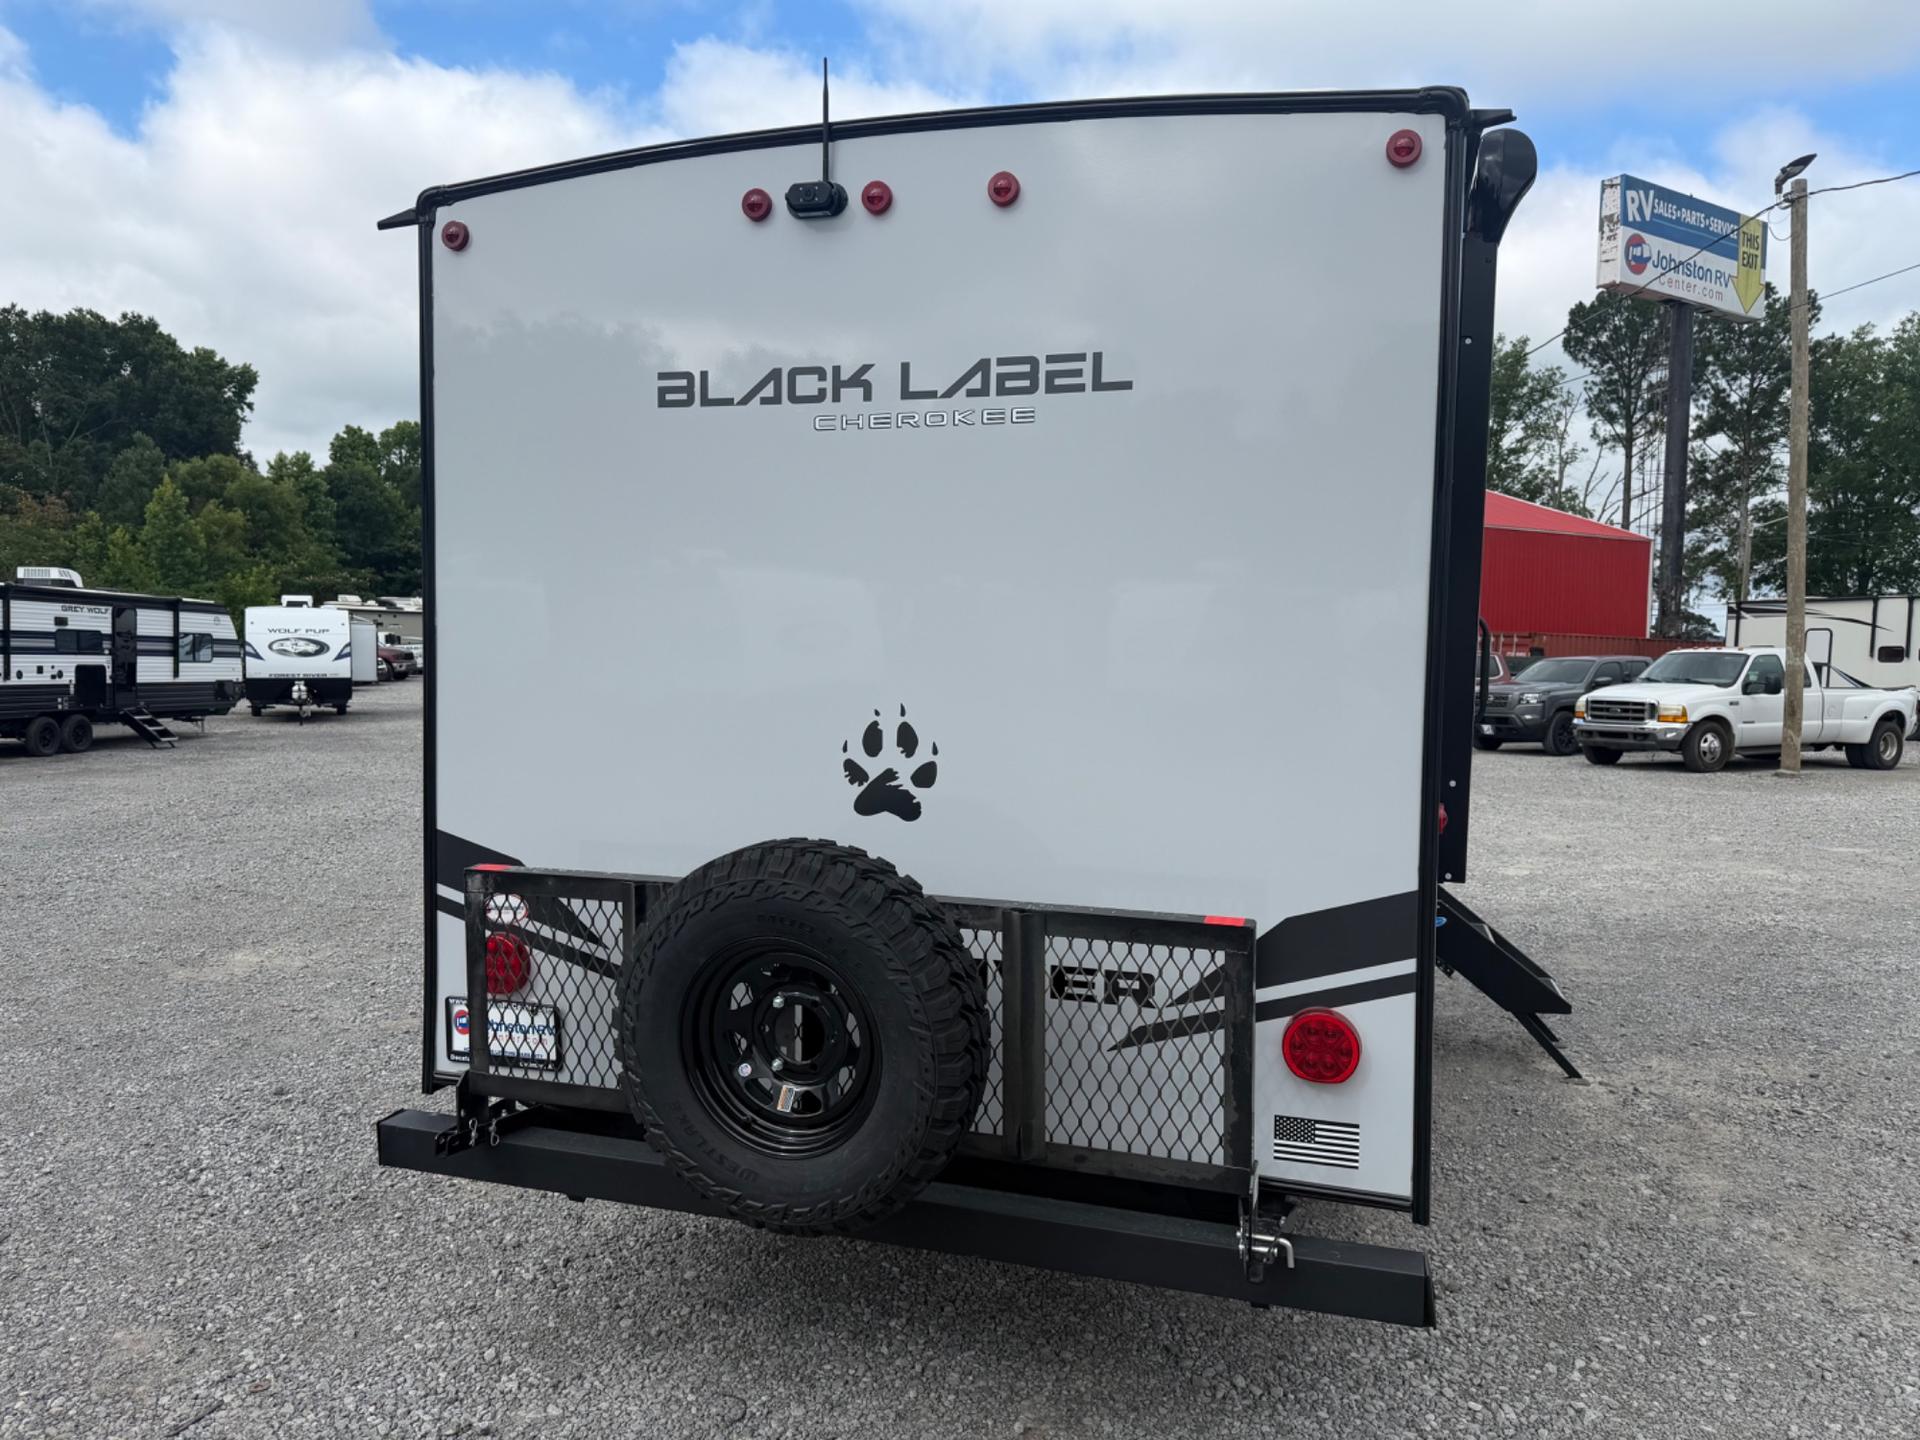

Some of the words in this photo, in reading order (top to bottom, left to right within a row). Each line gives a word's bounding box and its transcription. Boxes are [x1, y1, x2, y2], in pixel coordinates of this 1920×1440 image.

[1625, 189, 1655, 222] RV
[1653, 198, 1677, 219] SALES
[1681, 207, 1706, 228] PARTS
[1709, 216, 1739, 240] SERVICE
[1741, 231, 1760, 251] THIS
[1651, 249, 1713, 284] Johnston
[1714, 269, 1731, 289] RV
[1741, 251, 1759, 271] EXIT
[1658, 272, 1724, 302] Center.com
[657, 363, 876, 408] BLACK
[899, 351, 1134, 400] LABEL
[813, 406, 1036, 431] CHEROKEE
[61, 604, 85, 614] GREY
[86, 606, 110, 616] WOLF
